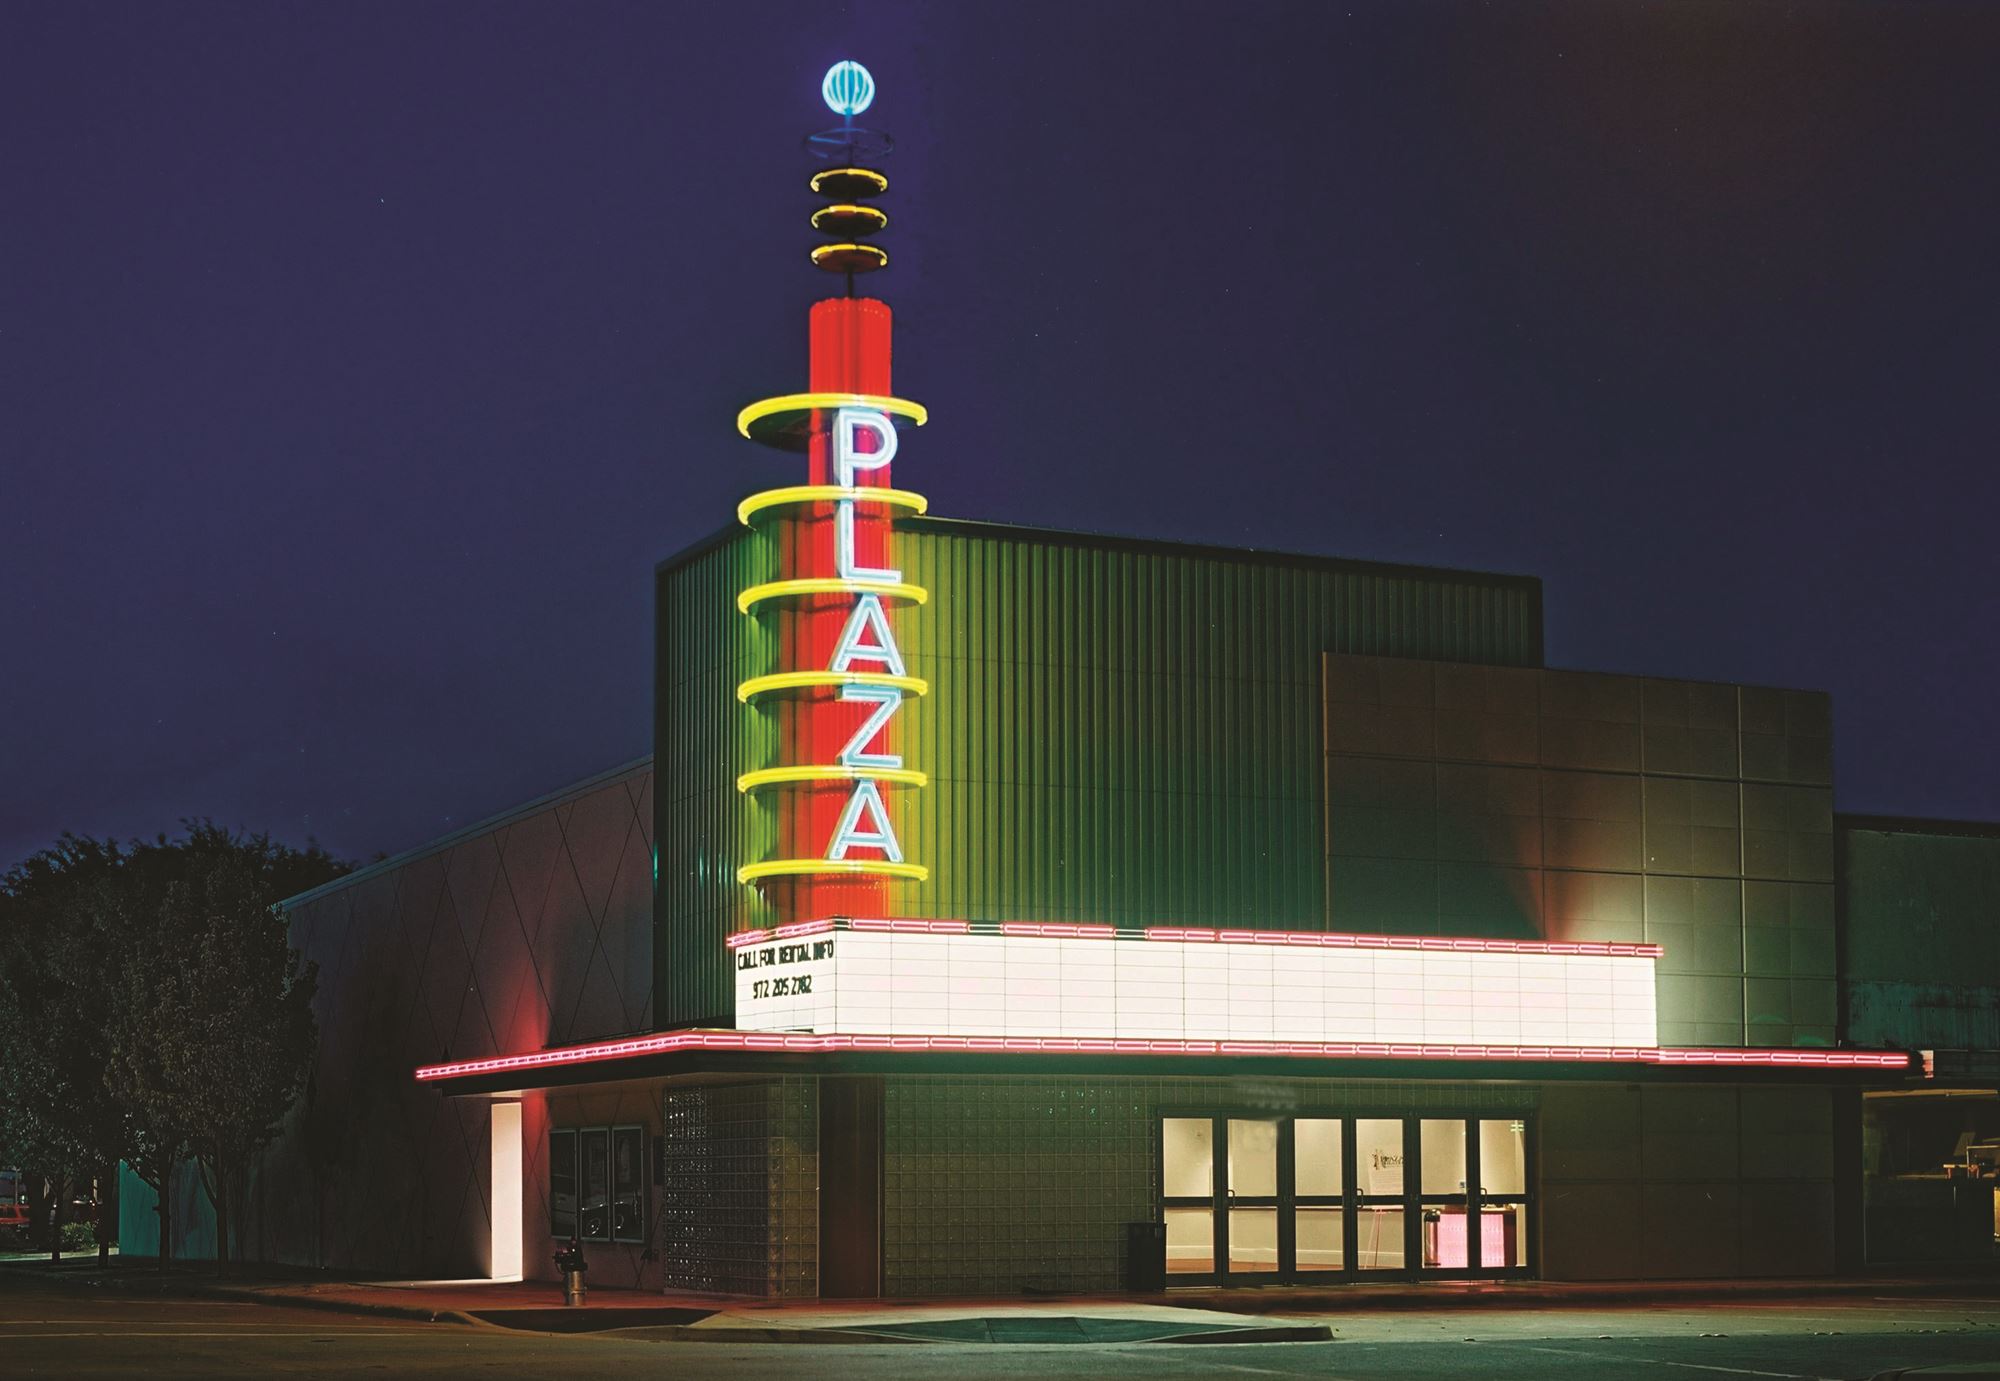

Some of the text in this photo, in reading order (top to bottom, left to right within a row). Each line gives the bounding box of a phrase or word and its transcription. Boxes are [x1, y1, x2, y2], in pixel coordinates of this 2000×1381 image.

[827, 407, 906, 863] PLAZA
[738, 939, 834, 971] CALL FOR RENTAL INFO
[753, 974, 812, 1000] 972 205 2782
